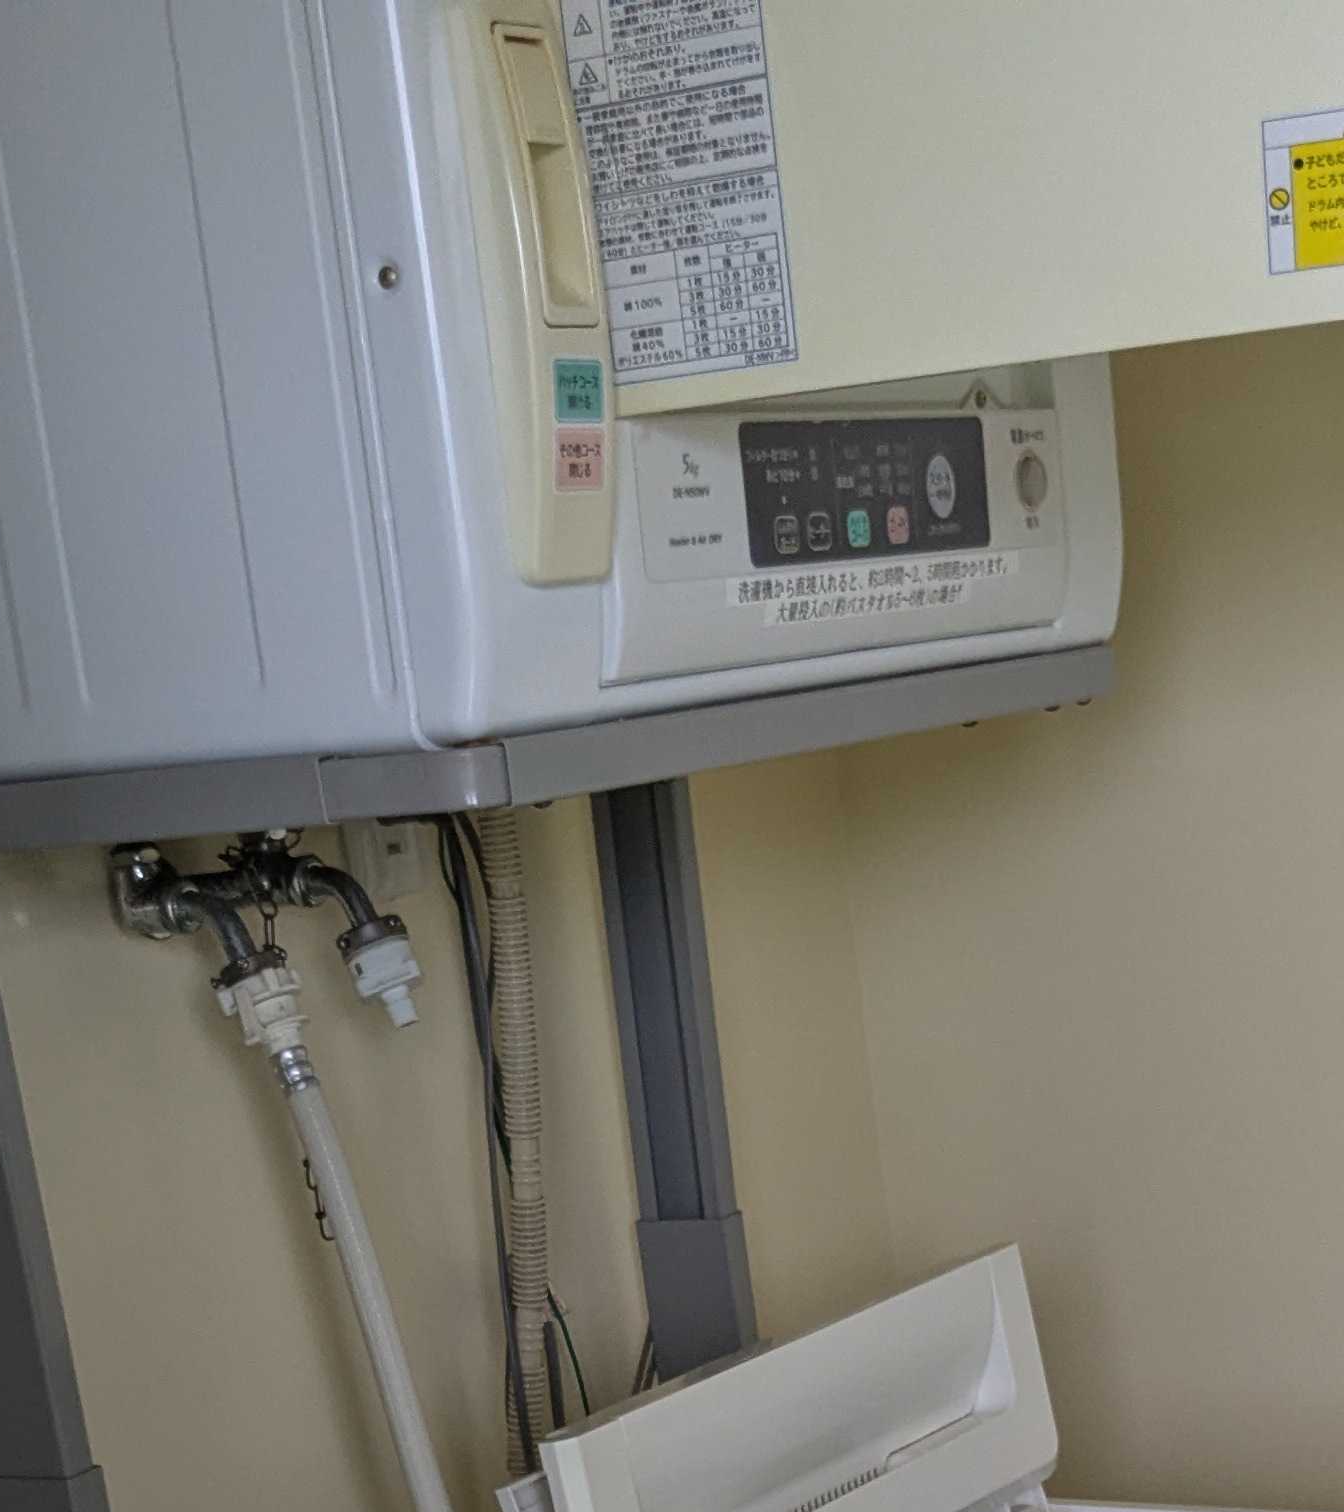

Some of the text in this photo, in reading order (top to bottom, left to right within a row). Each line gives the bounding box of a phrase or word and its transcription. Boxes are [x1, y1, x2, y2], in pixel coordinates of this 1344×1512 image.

[1270, 214, 1291, 227] 禁止
[725, 240, 759, 254] ヒーター
